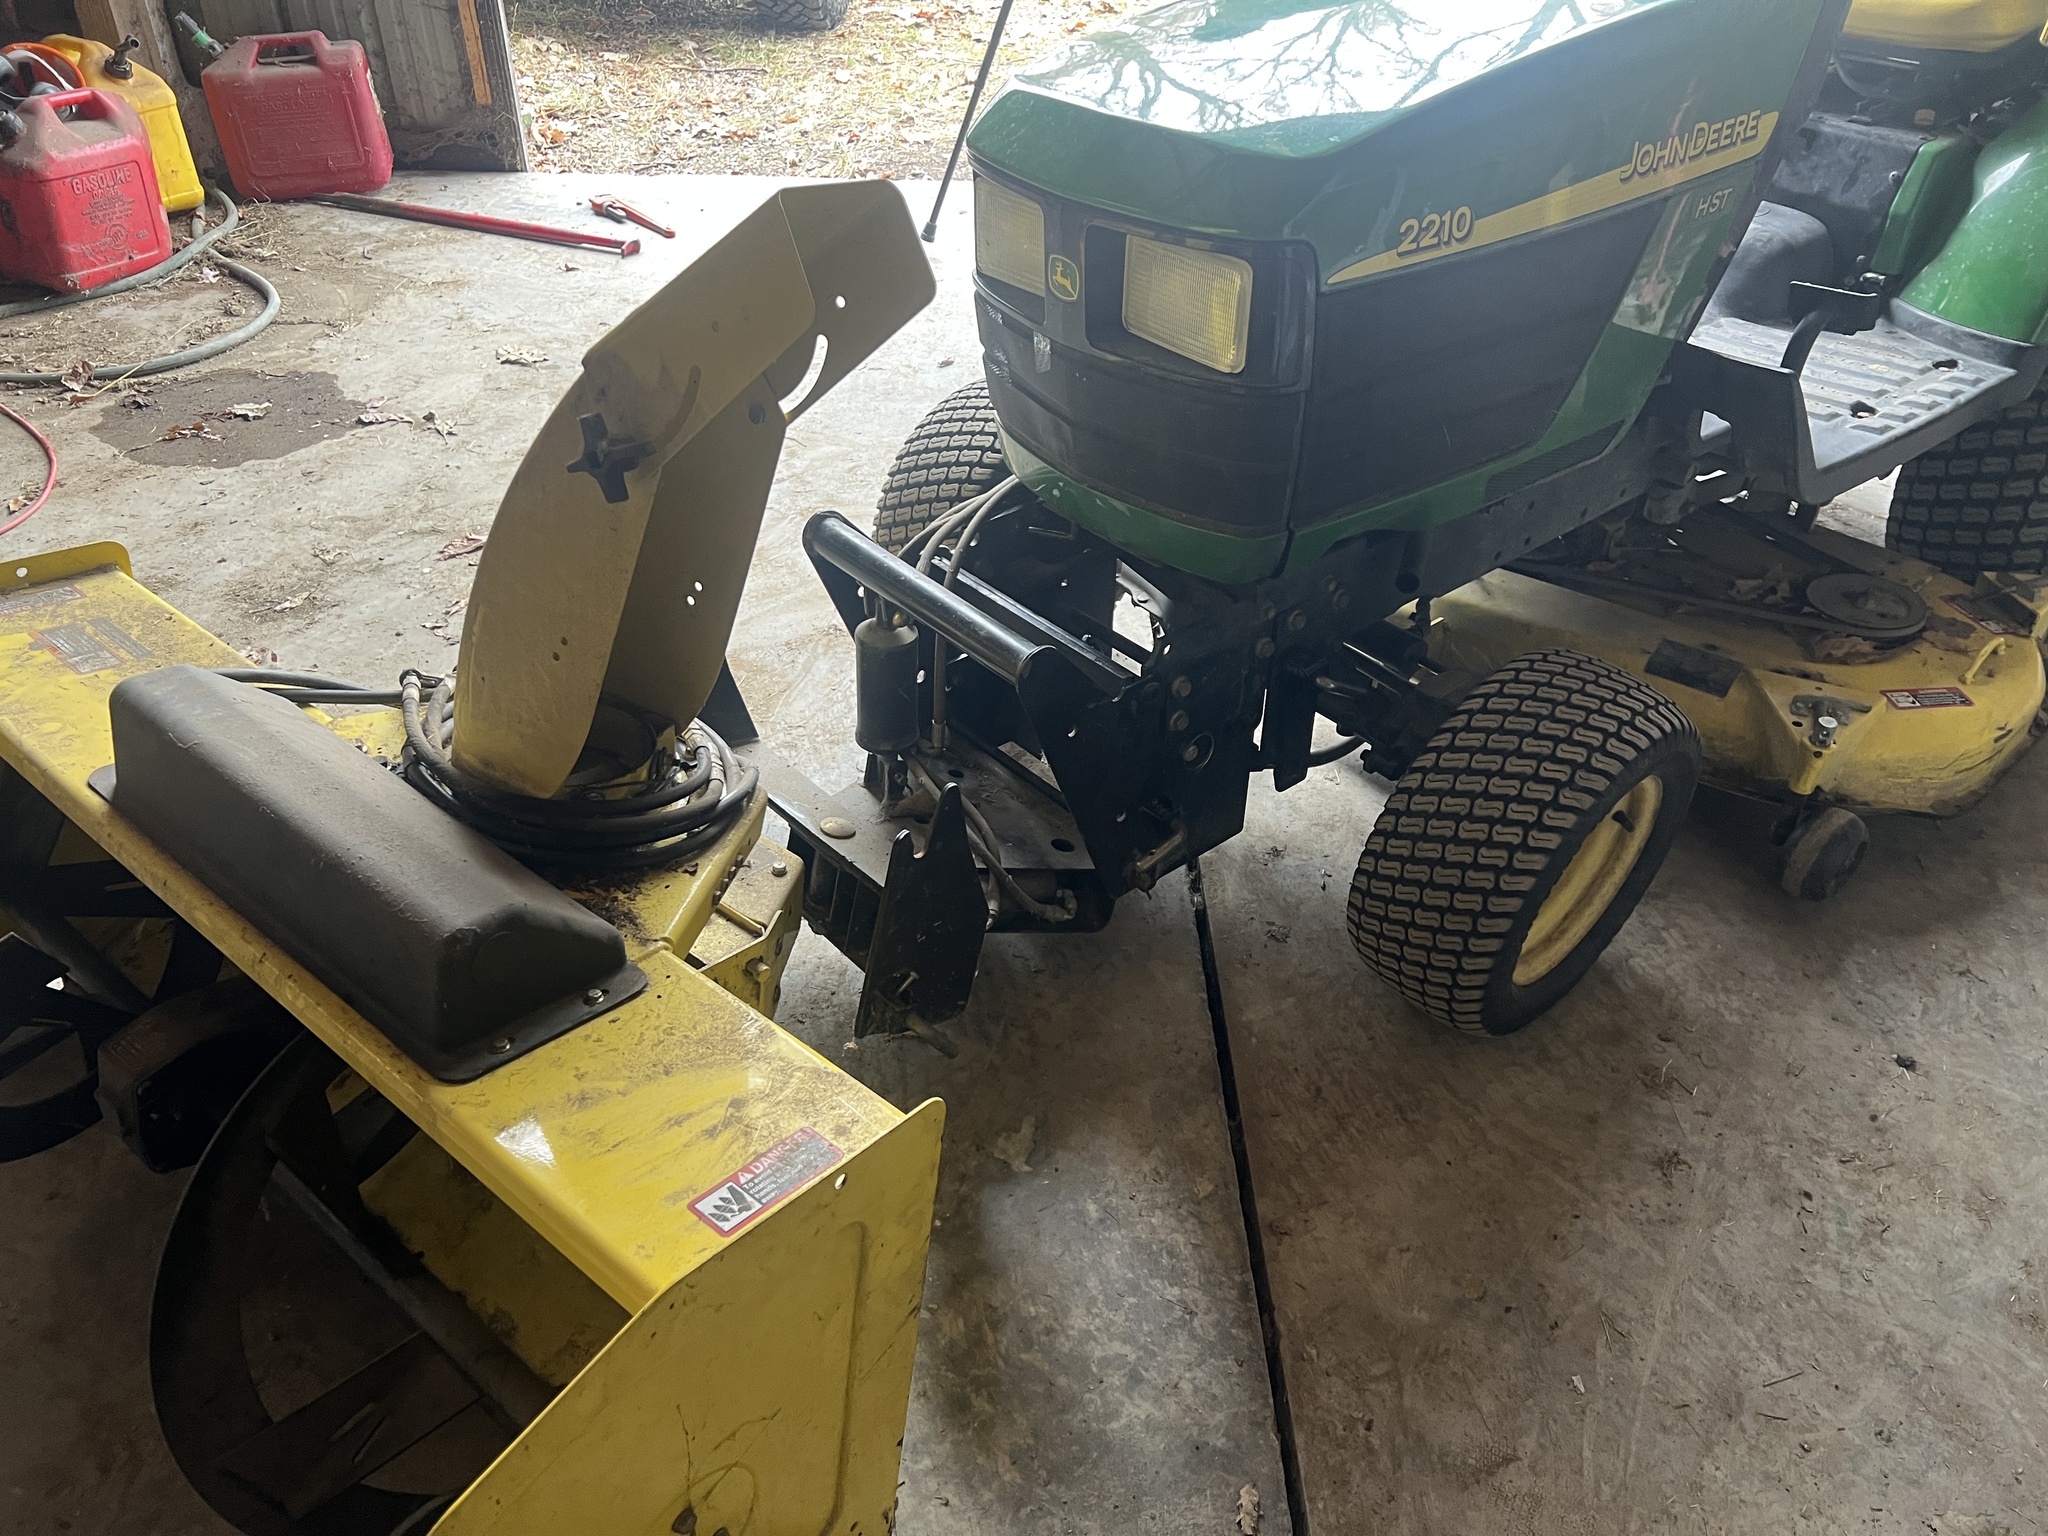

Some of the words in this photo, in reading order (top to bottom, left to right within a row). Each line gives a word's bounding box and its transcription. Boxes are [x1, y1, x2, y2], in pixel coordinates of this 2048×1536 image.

[1619, 133, 1690, 183] JOHN
[1687, 109, 1762, 158] DEERE
[70, 167, 133, 196] GASOLINE
[1695, 187, 1734, 219] HST
[1396, 205, 1474, 257] 2210
[742, 1181, 754, 1190] To
[752, 1168, 773, 1183] avoid
[749, 1175, 776, 1195] rotating
